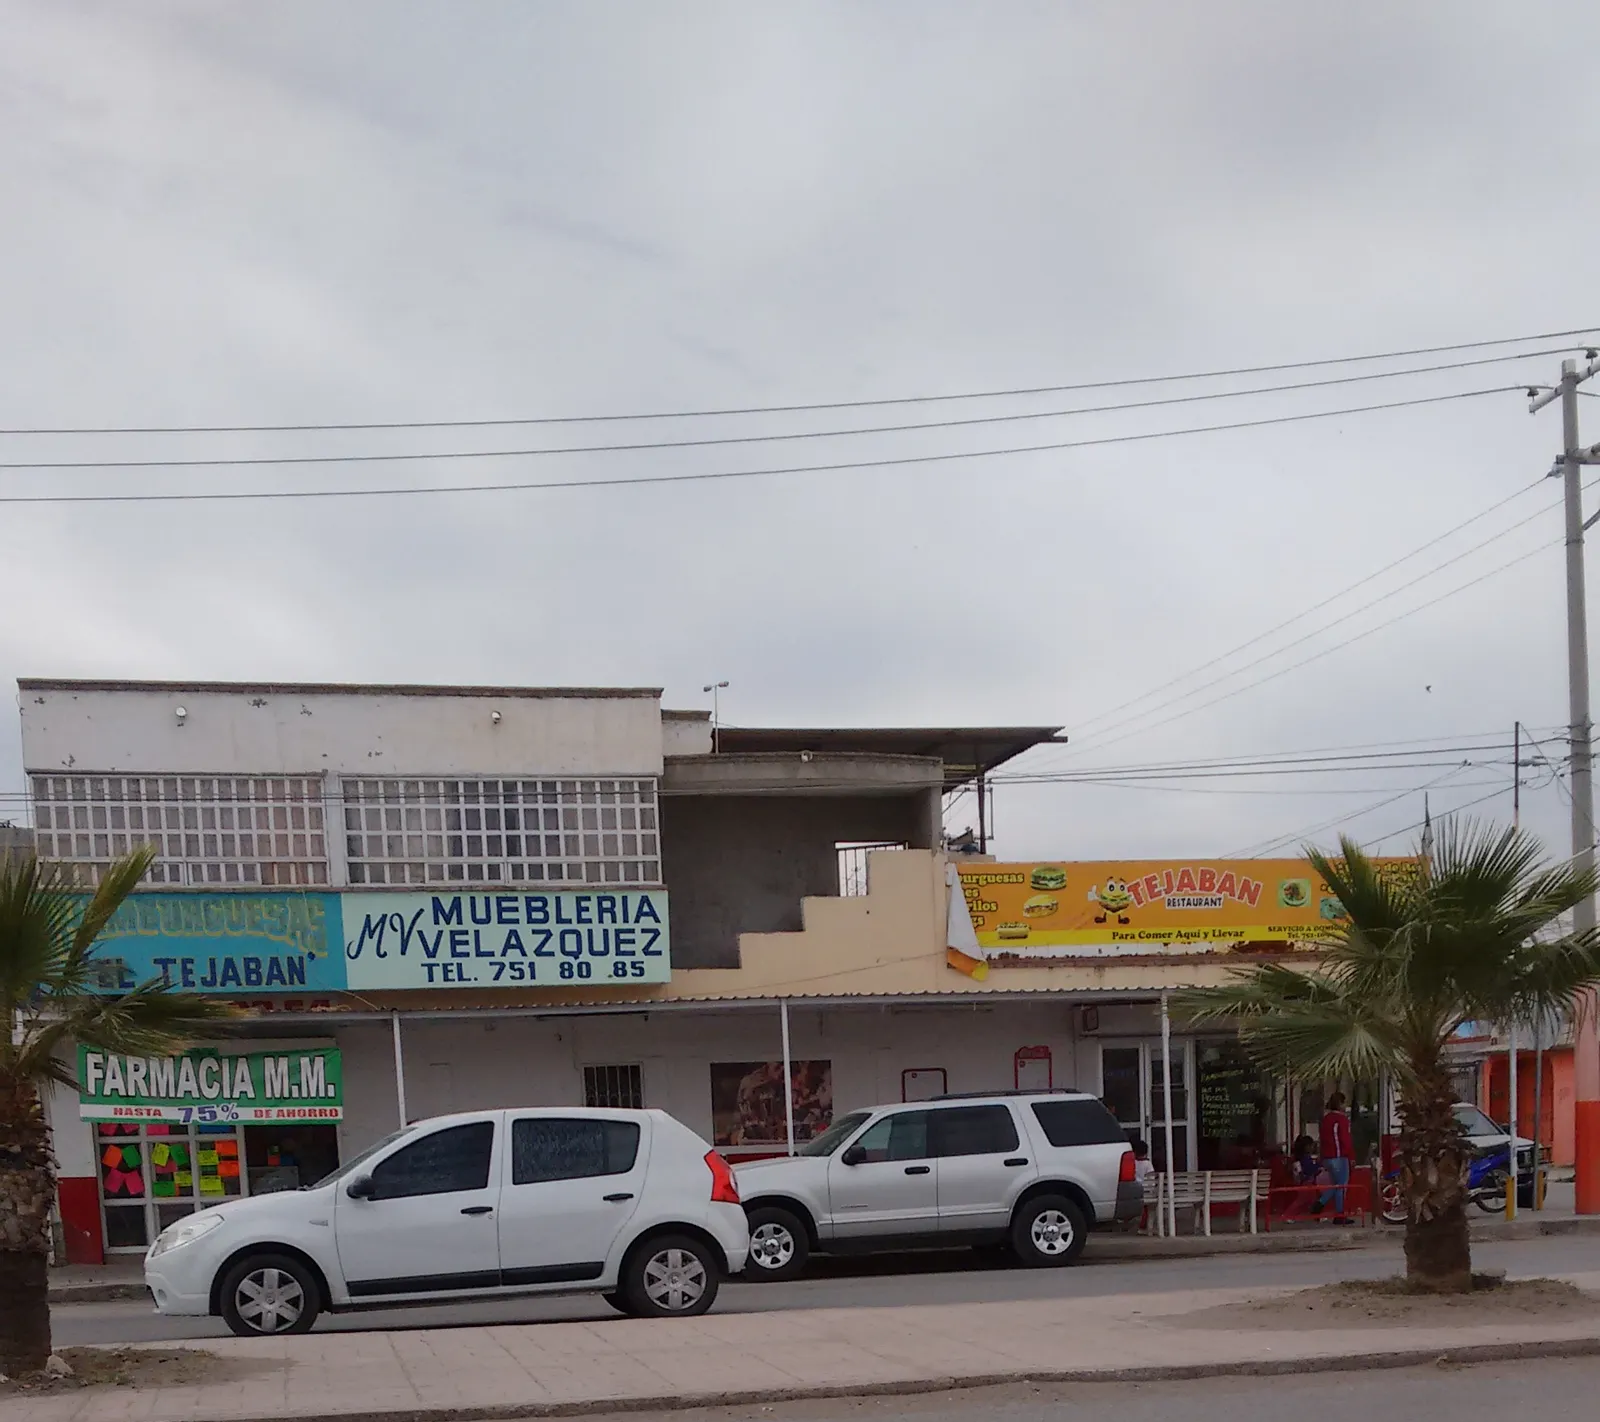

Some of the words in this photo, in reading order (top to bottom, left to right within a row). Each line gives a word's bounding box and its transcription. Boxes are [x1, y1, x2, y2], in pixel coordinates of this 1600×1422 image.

[1127, 867, 1263, 908] TEJABAN
[1165, 897, 1222, 907] RESTAURANT
[431, 895, 661, 926] MUEBLERIA
[416, 928, 663, 960] VELAZQUEZ
[1112, 931, 1136, 940] Para
[1138, 930, 1173, 940] Comer
[1203, 931, 1209, 939] y
[1212, 928, 1245, 938] Llevar
[153, 955, 305, 988] TEJABAN
[421, 963, 478, 983] TEL.
[489, 961, 537, 981] 751
[559, 961, 592, 979] 80
[613, 960, 645, 977] 85
[86, 1053, 256, 1100] FARMACIA
[264, 1055, 336, 1099] M.M.
[113, 1107, 162, 1117] HASTA
[178, 1103, 240, 1124] 75%
[254, 1109, 273, 1119] DE
[276, 1108, 339, 1118] AHORRO
